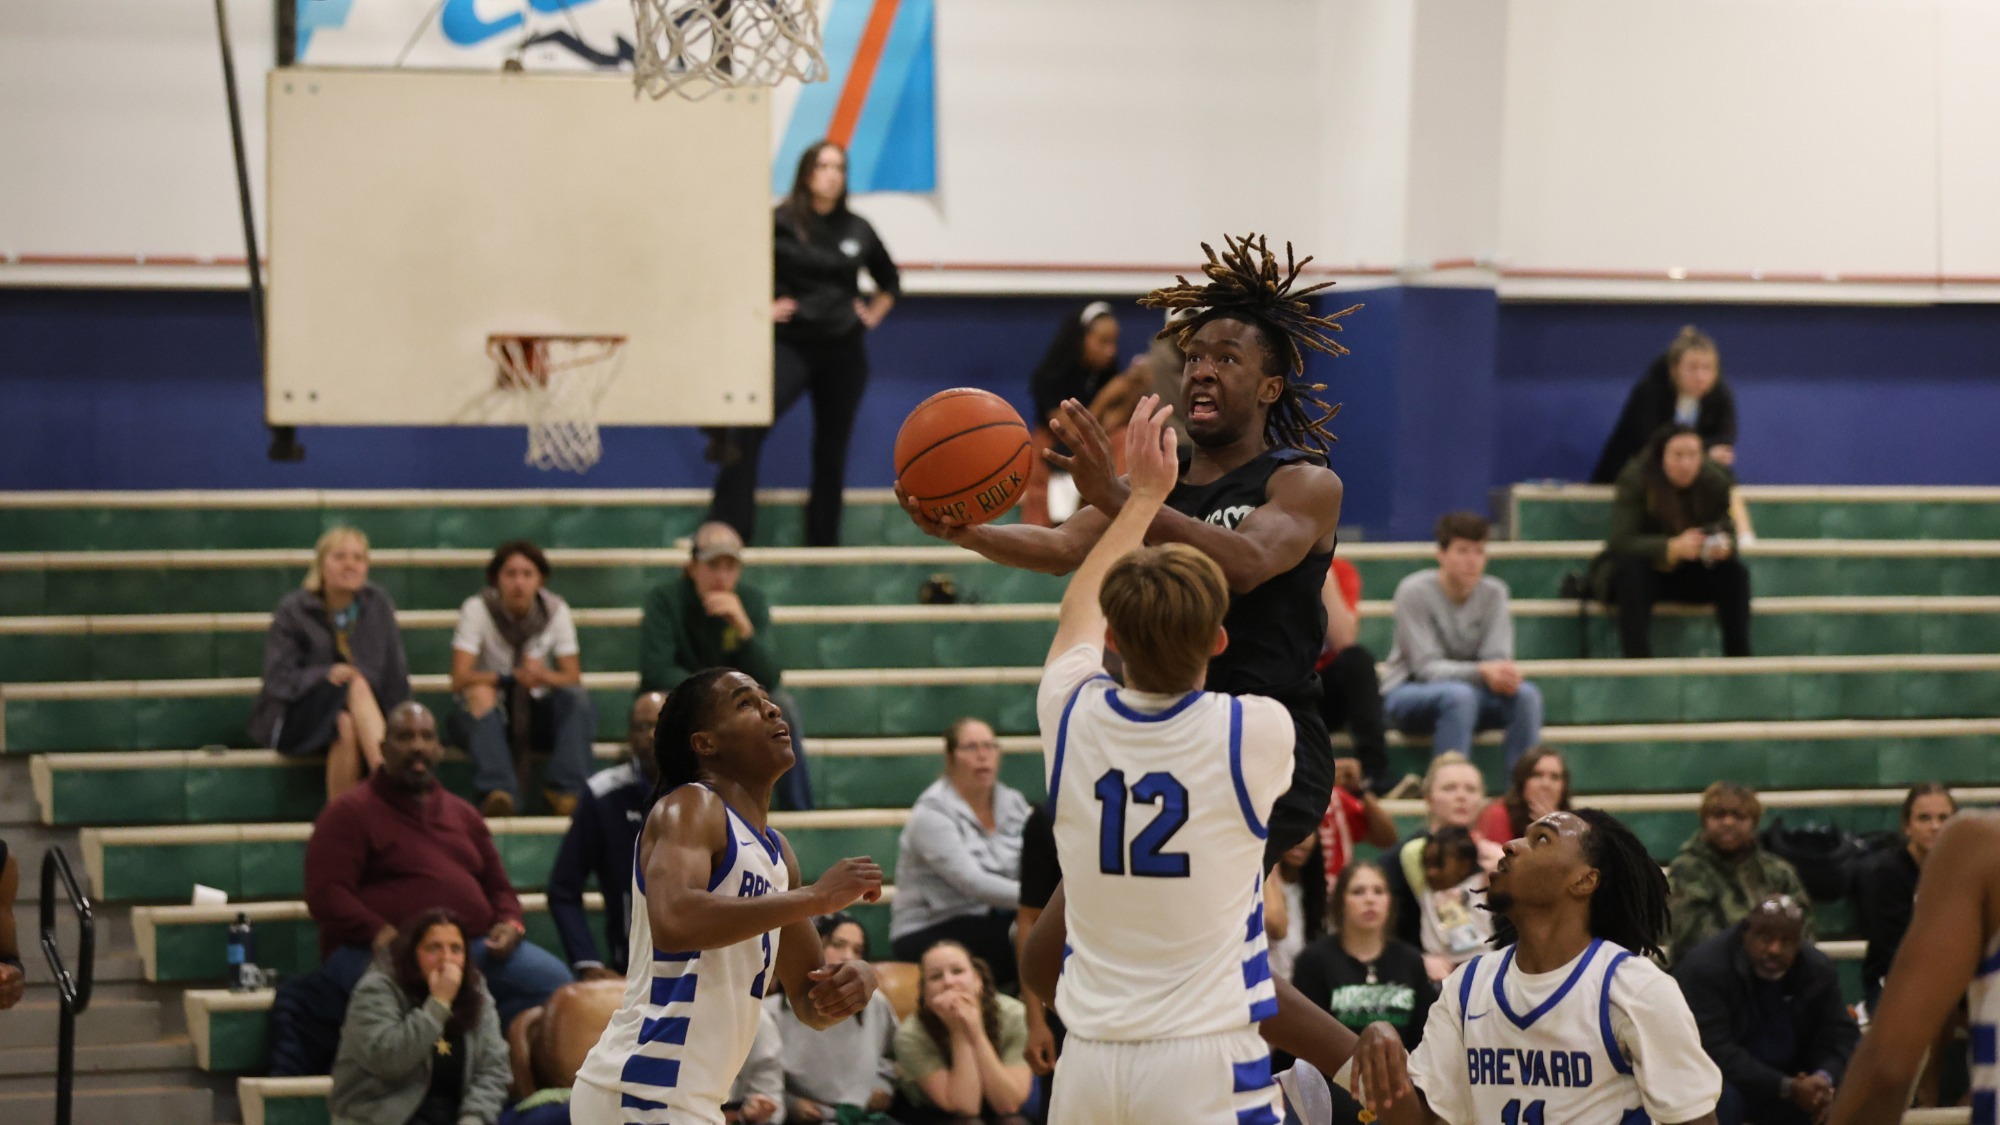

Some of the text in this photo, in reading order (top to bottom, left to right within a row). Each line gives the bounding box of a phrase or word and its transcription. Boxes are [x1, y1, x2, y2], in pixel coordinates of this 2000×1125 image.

[975, 472, 1022, 513] ROCK
[1094, 768, 1191, 878] 12
[1467, 1047, 1593, 1088] BREVARD
